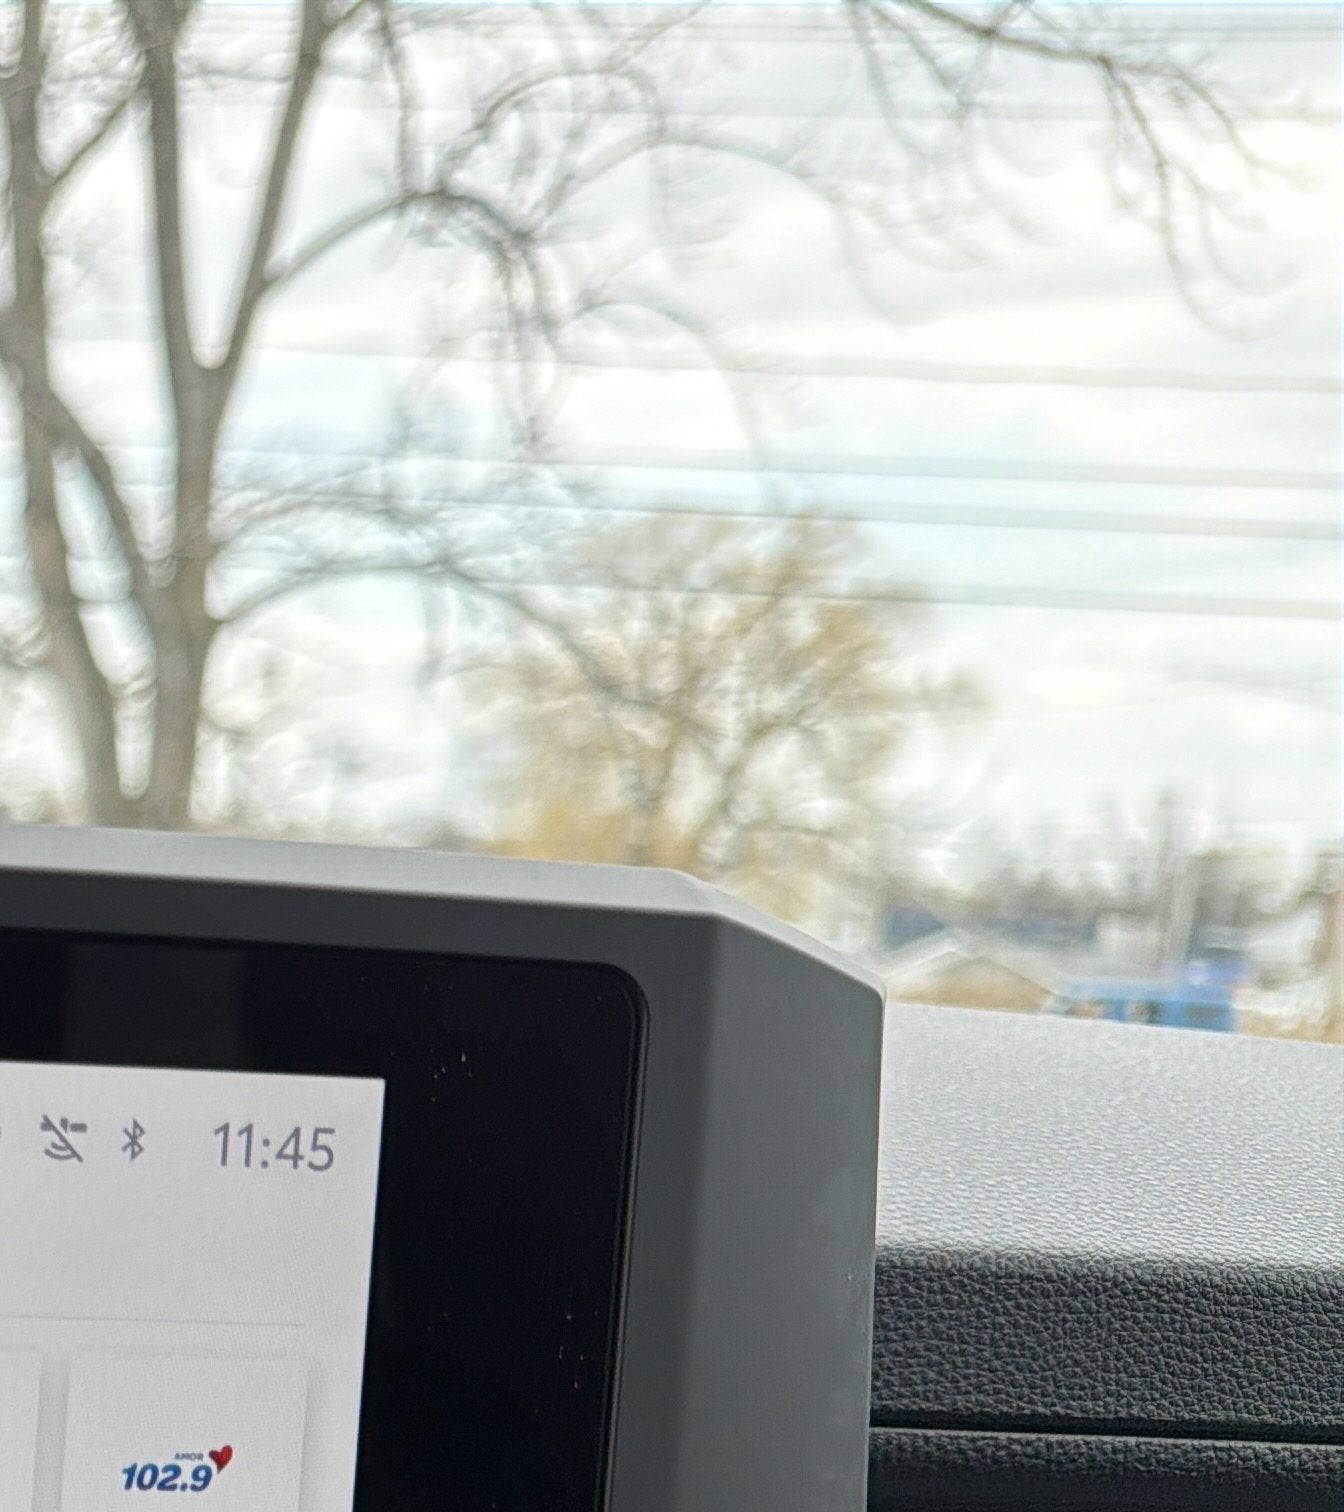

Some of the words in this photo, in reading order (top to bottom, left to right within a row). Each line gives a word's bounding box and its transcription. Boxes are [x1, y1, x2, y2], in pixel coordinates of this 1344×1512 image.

[213, 1121, 337, 1173] 11:45
[174, 1452, 204, 1461] AMOR
[122, 1461, 213, 1492] 102.9
